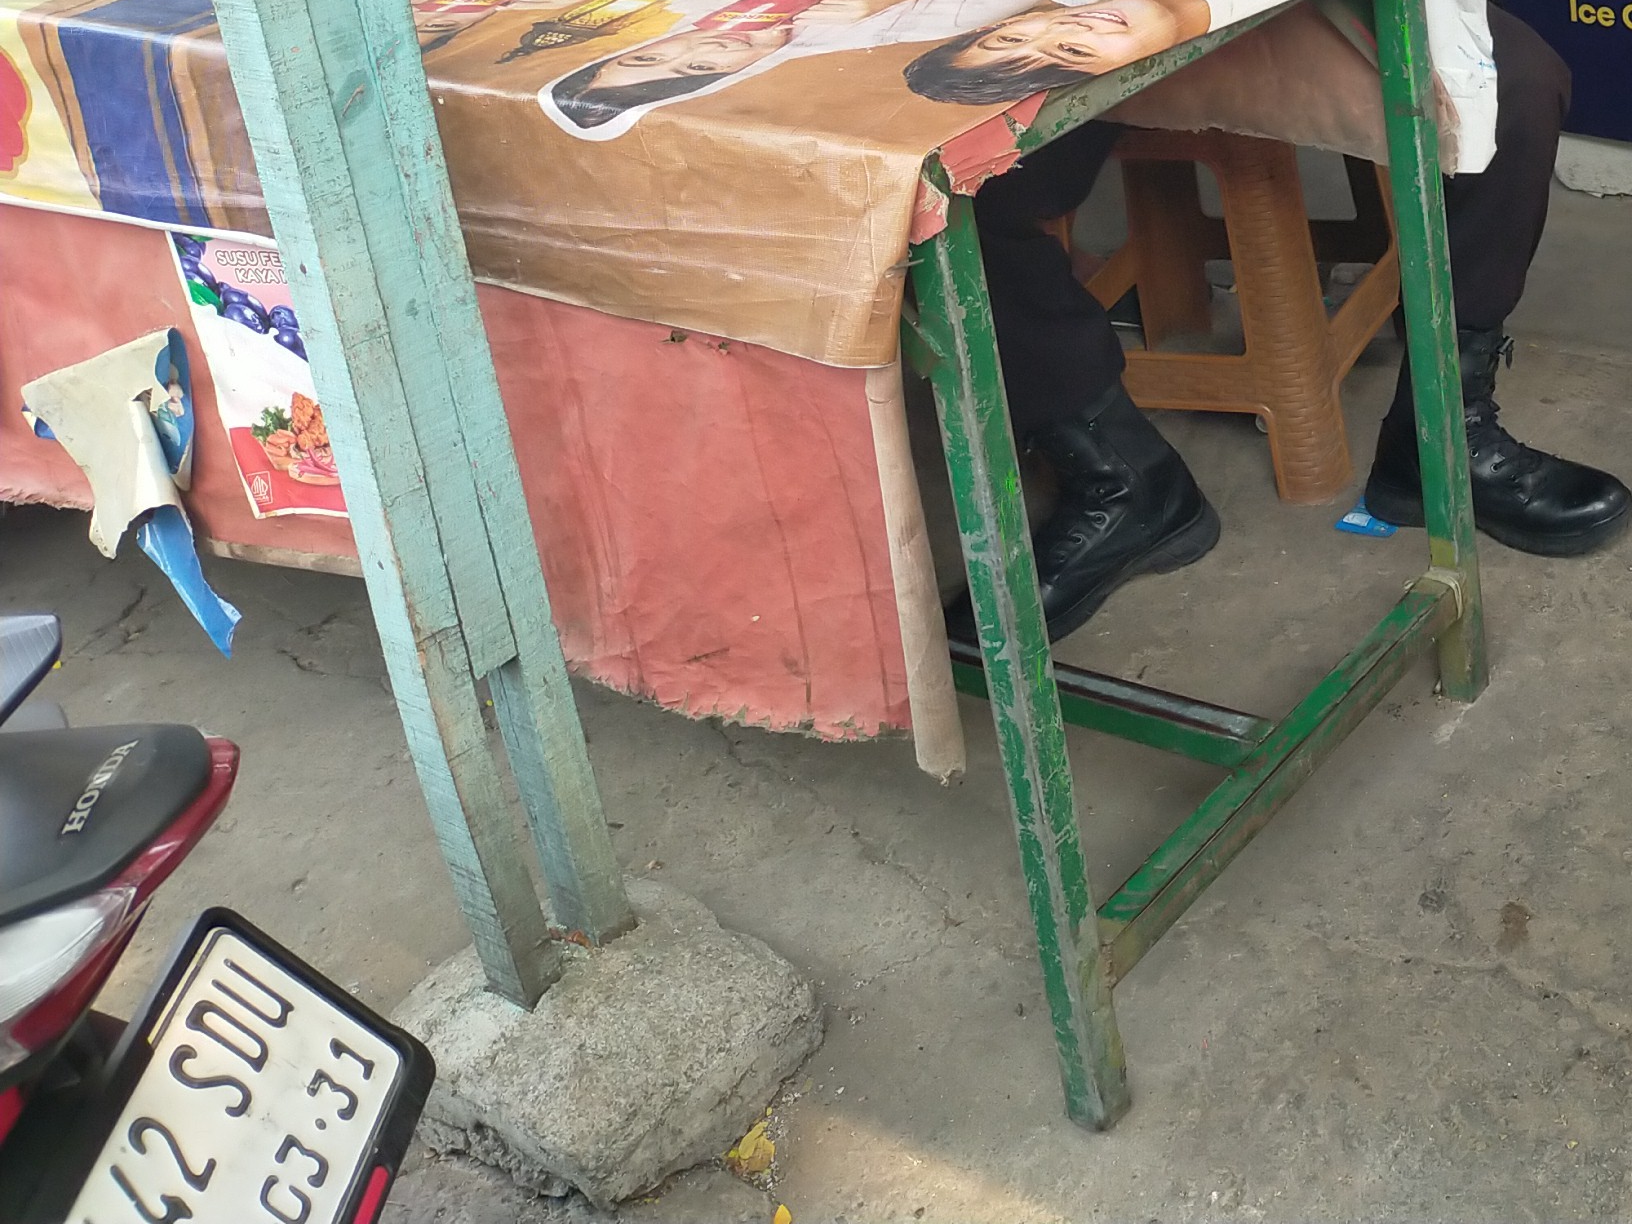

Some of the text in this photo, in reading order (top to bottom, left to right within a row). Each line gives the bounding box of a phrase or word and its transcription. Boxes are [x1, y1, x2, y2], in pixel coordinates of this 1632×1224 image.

[215, 250, 281, 268] SUSU FE
[236, 268, 278, 284] KAYA
[61, 739, 140, 837] HONDA
[108, 957, 295, 1224] 42 SDU
